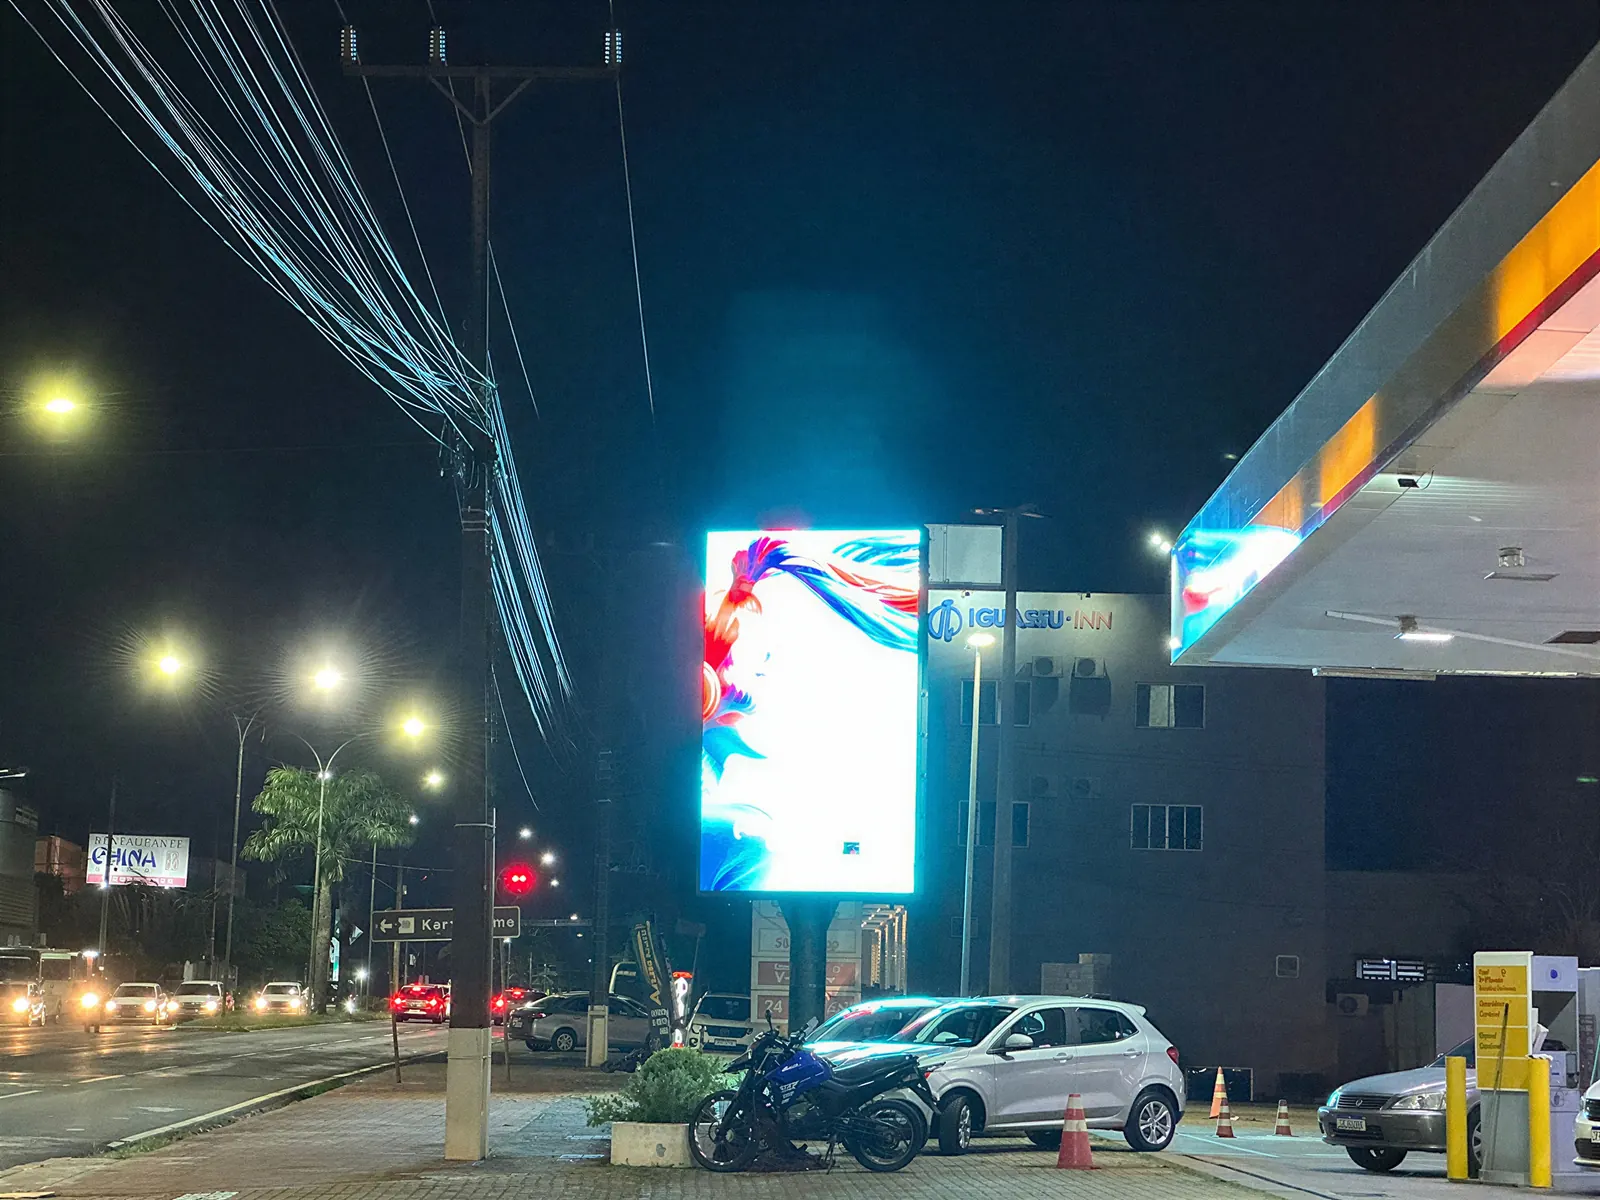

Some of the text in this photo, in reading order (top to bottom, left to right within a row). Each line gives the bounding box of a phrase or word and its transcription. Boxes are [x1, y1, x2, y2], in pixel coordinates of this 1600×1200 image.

[1073, 609, 1113, 630] INN
[94, 835, 184, 849] REAUANE
[92, 846, 156, 868] CHINA
[764, 1000, 783, 1014] 24
